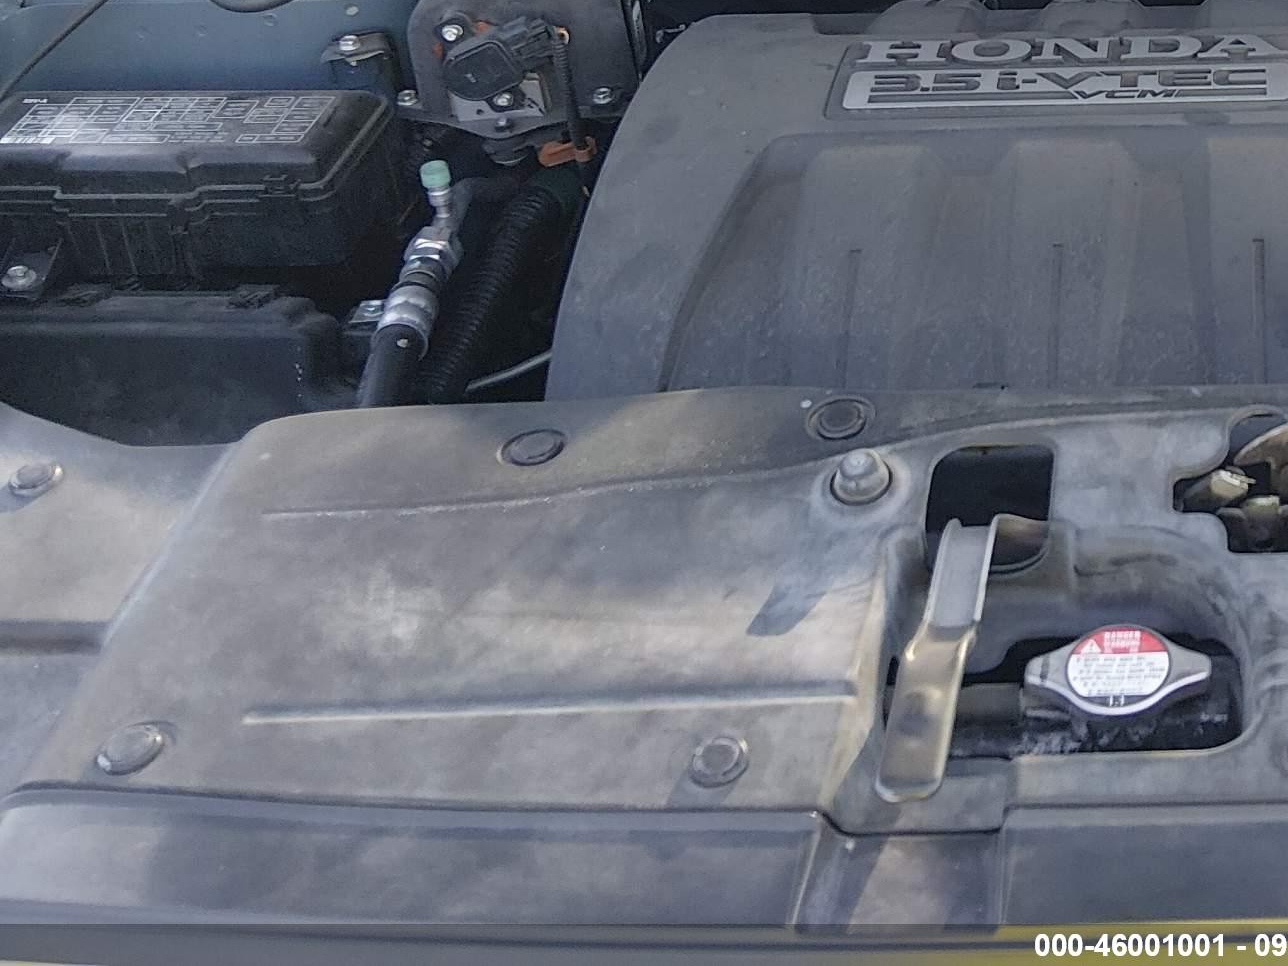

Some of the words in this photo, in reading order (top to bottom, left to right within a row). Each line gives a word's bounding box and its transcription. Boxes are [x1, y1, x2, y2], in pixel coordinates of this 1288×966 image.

[856, 37, 1288, 63] HONDA
[869, 72, 982, 93] 3.5
[1073, 88, 1177, 100] VCM
